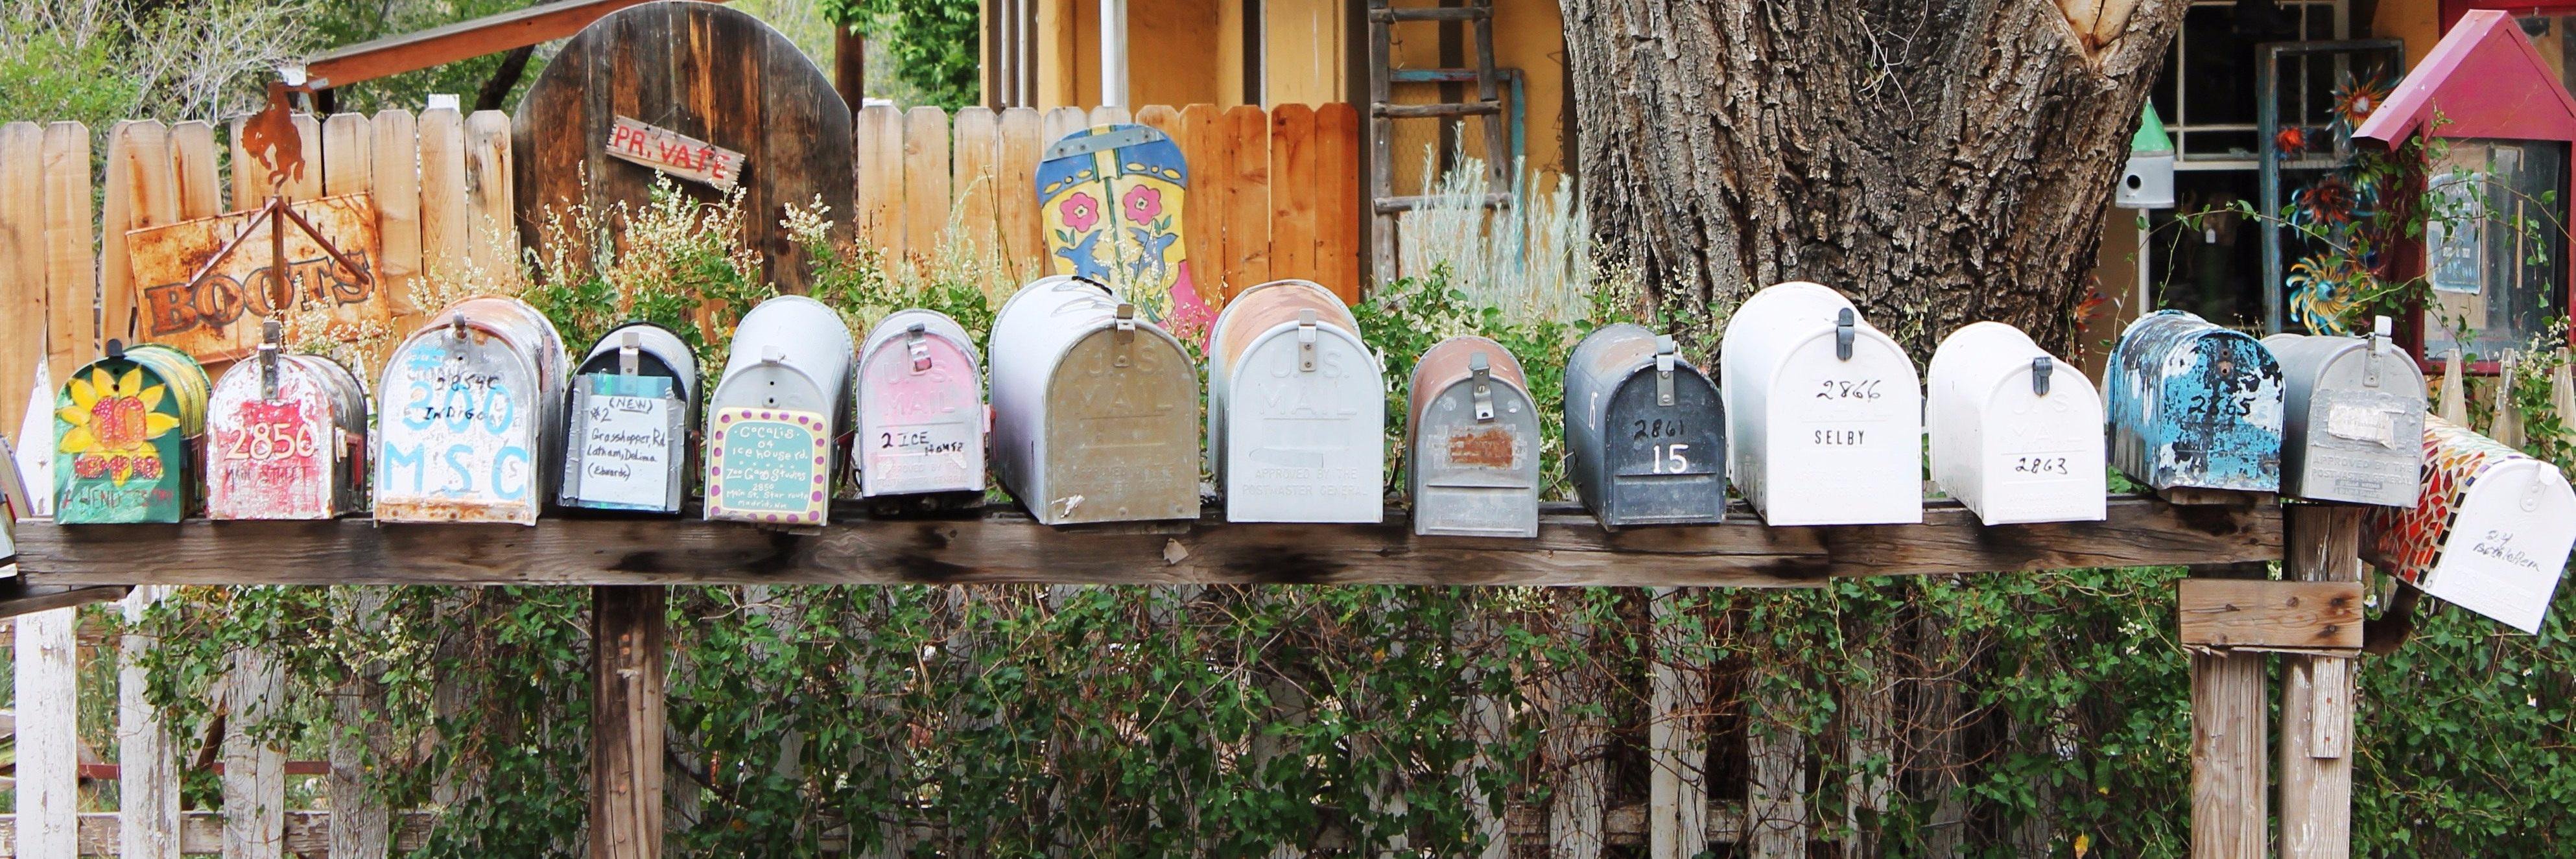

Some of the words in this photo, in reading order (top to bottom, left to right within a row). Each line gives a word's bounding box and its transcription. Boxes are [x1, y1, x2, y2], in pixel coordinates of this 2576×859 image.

[613, 126, 731, 180] PRVATE
[144, 250, 375, 337] BOOTS
[1258, 383, 1357, 416] MAIL
[1816, 379, 1882, 403] 2866
[403, 380, 514, 436] 300
[609, 397, 654, 414] (NEW)
[882, 390, 956, 416] MAIL
[2188, 394, 2256, 416] 2865
[91, 395, 147, 451] 10
[1634, 419, 1684, 441] 2861
[225, 421, 316, 460] 2850
[652, 427, 666, 447] Rd
[880, 431, 895, 449] 2
[897, 430, 930, 447] ICE
[1815, 429, 1865, 445] SELBY
[756, 449, 791, 461] house
[794, 448, 808, 460] rd.
[1653, 443, 1690, 475] 15
[2313, 454, 2370, 469] APPROVED
[2374, 459, 2389, 471] BY
[2393, 461, 2415, 474] THE
[383, 441, 528, 500] MSC
[1255, 467, 1310, 480] APPROVED
[1316, 467, 1330, 480] BY
[1336, 467, 1358, 480] THE
[2015, 456, 2068, 476] 2863
[752, 483, 775, 492] 2850
[1242, 484, 1313, 496] POSTMASTER
[1319, 484, 1369, 497] GENERAL
